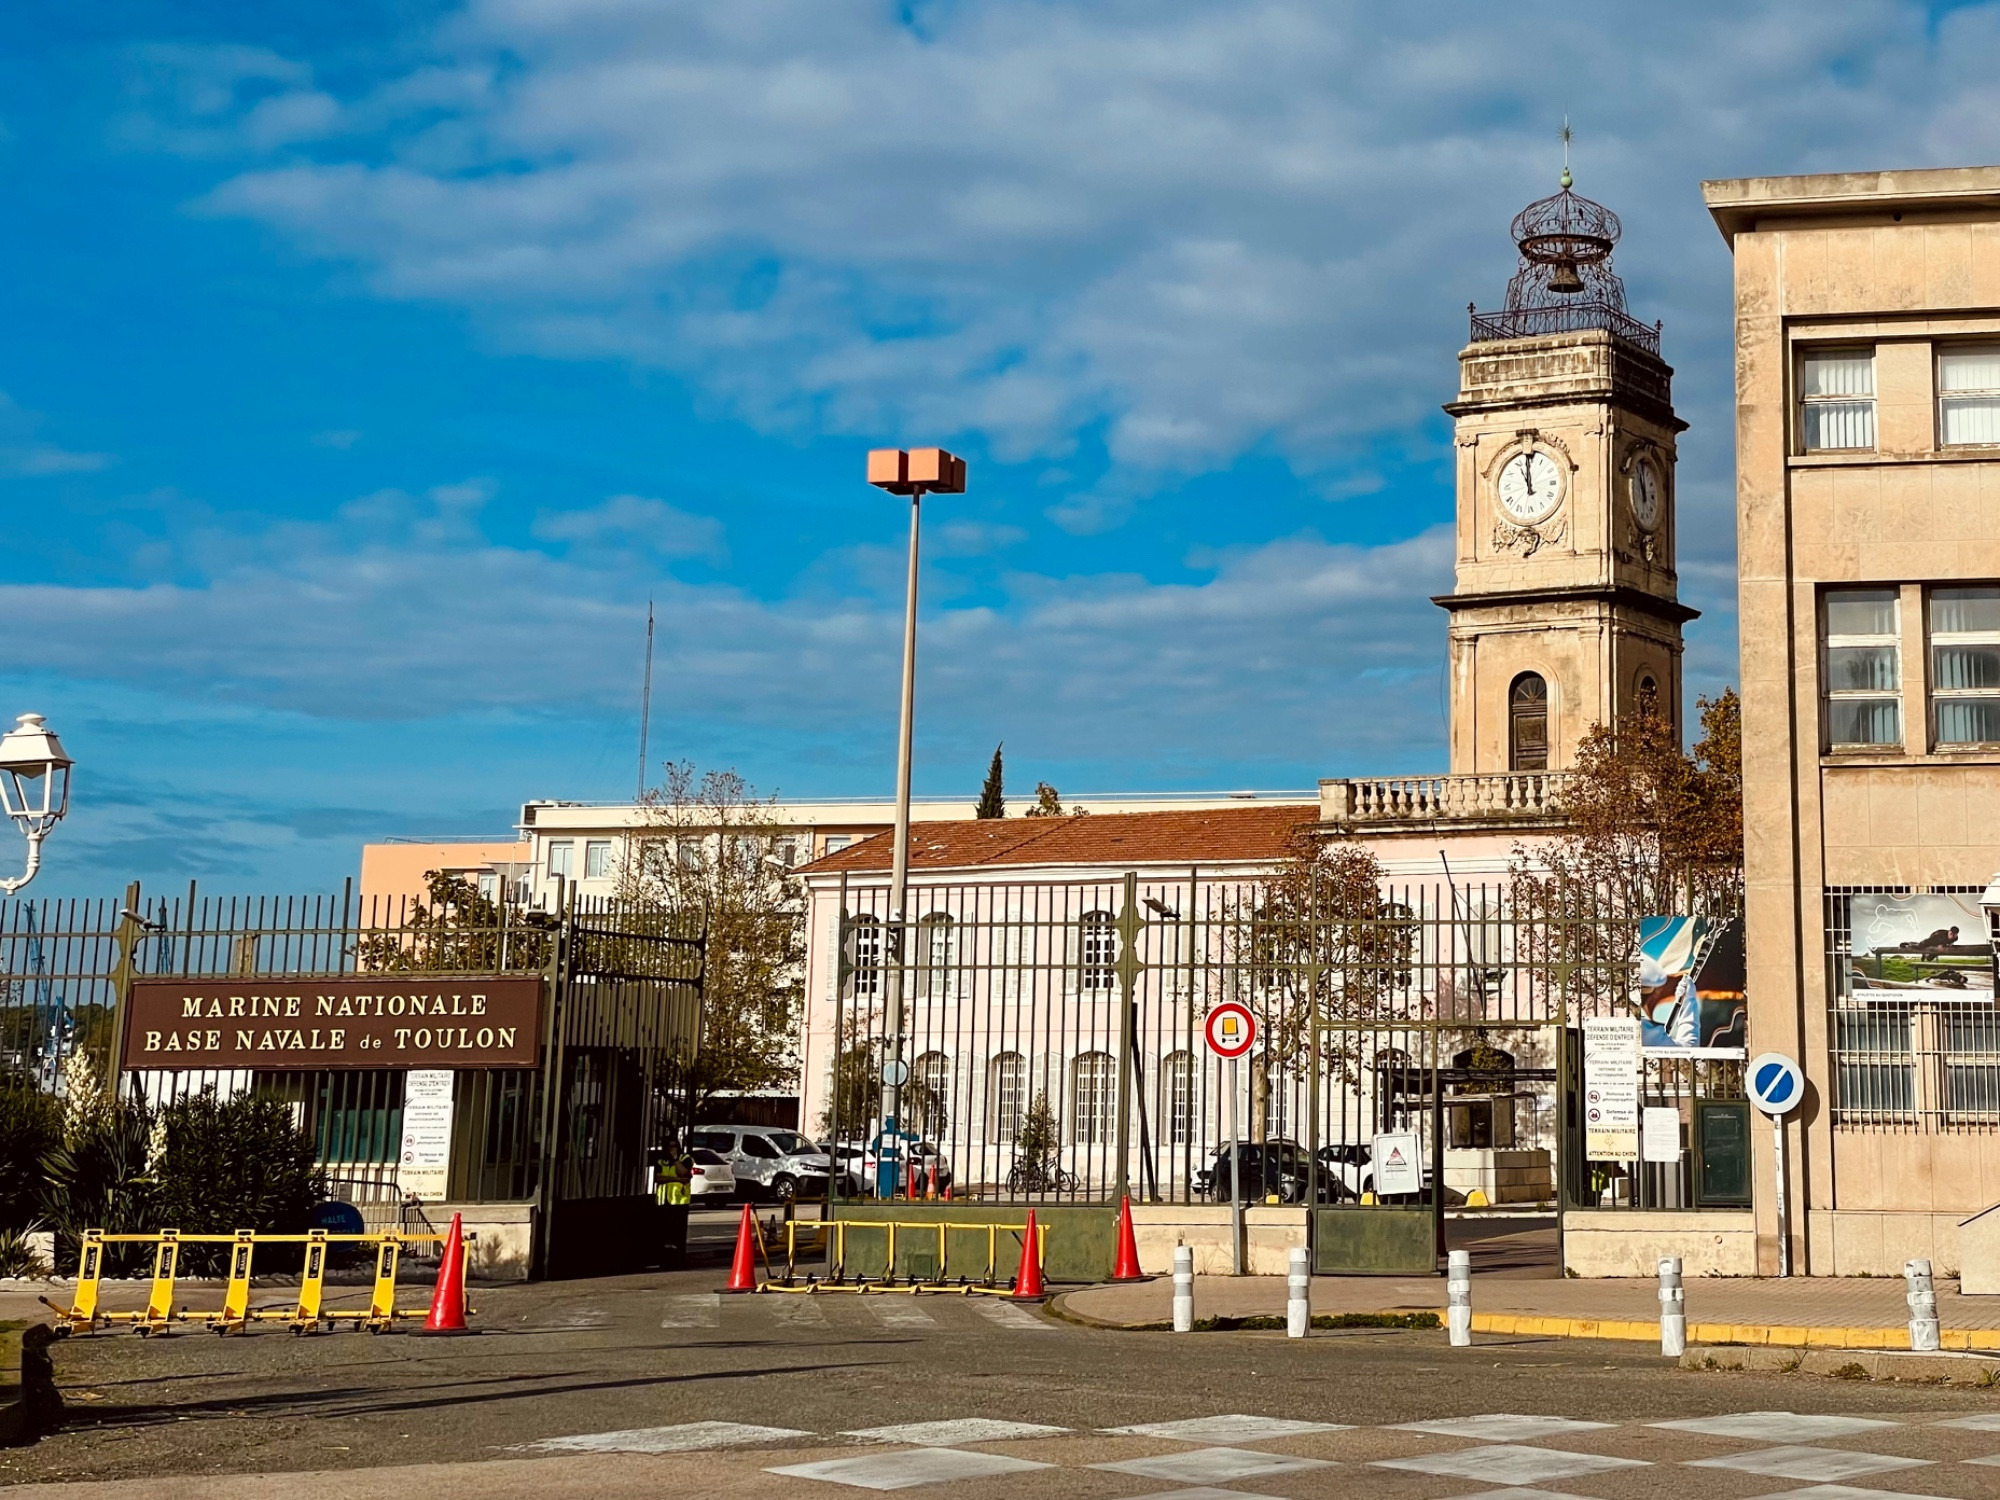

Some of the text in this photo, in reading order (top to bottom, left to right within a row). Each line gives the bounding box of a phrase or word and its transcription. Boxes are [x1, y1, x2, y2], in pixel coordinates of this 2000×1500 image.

[181, 995, 487, 1018] MARINE NATIONALE
[144, 1027, 517, 1051] BASE NAVALE de TOULON
